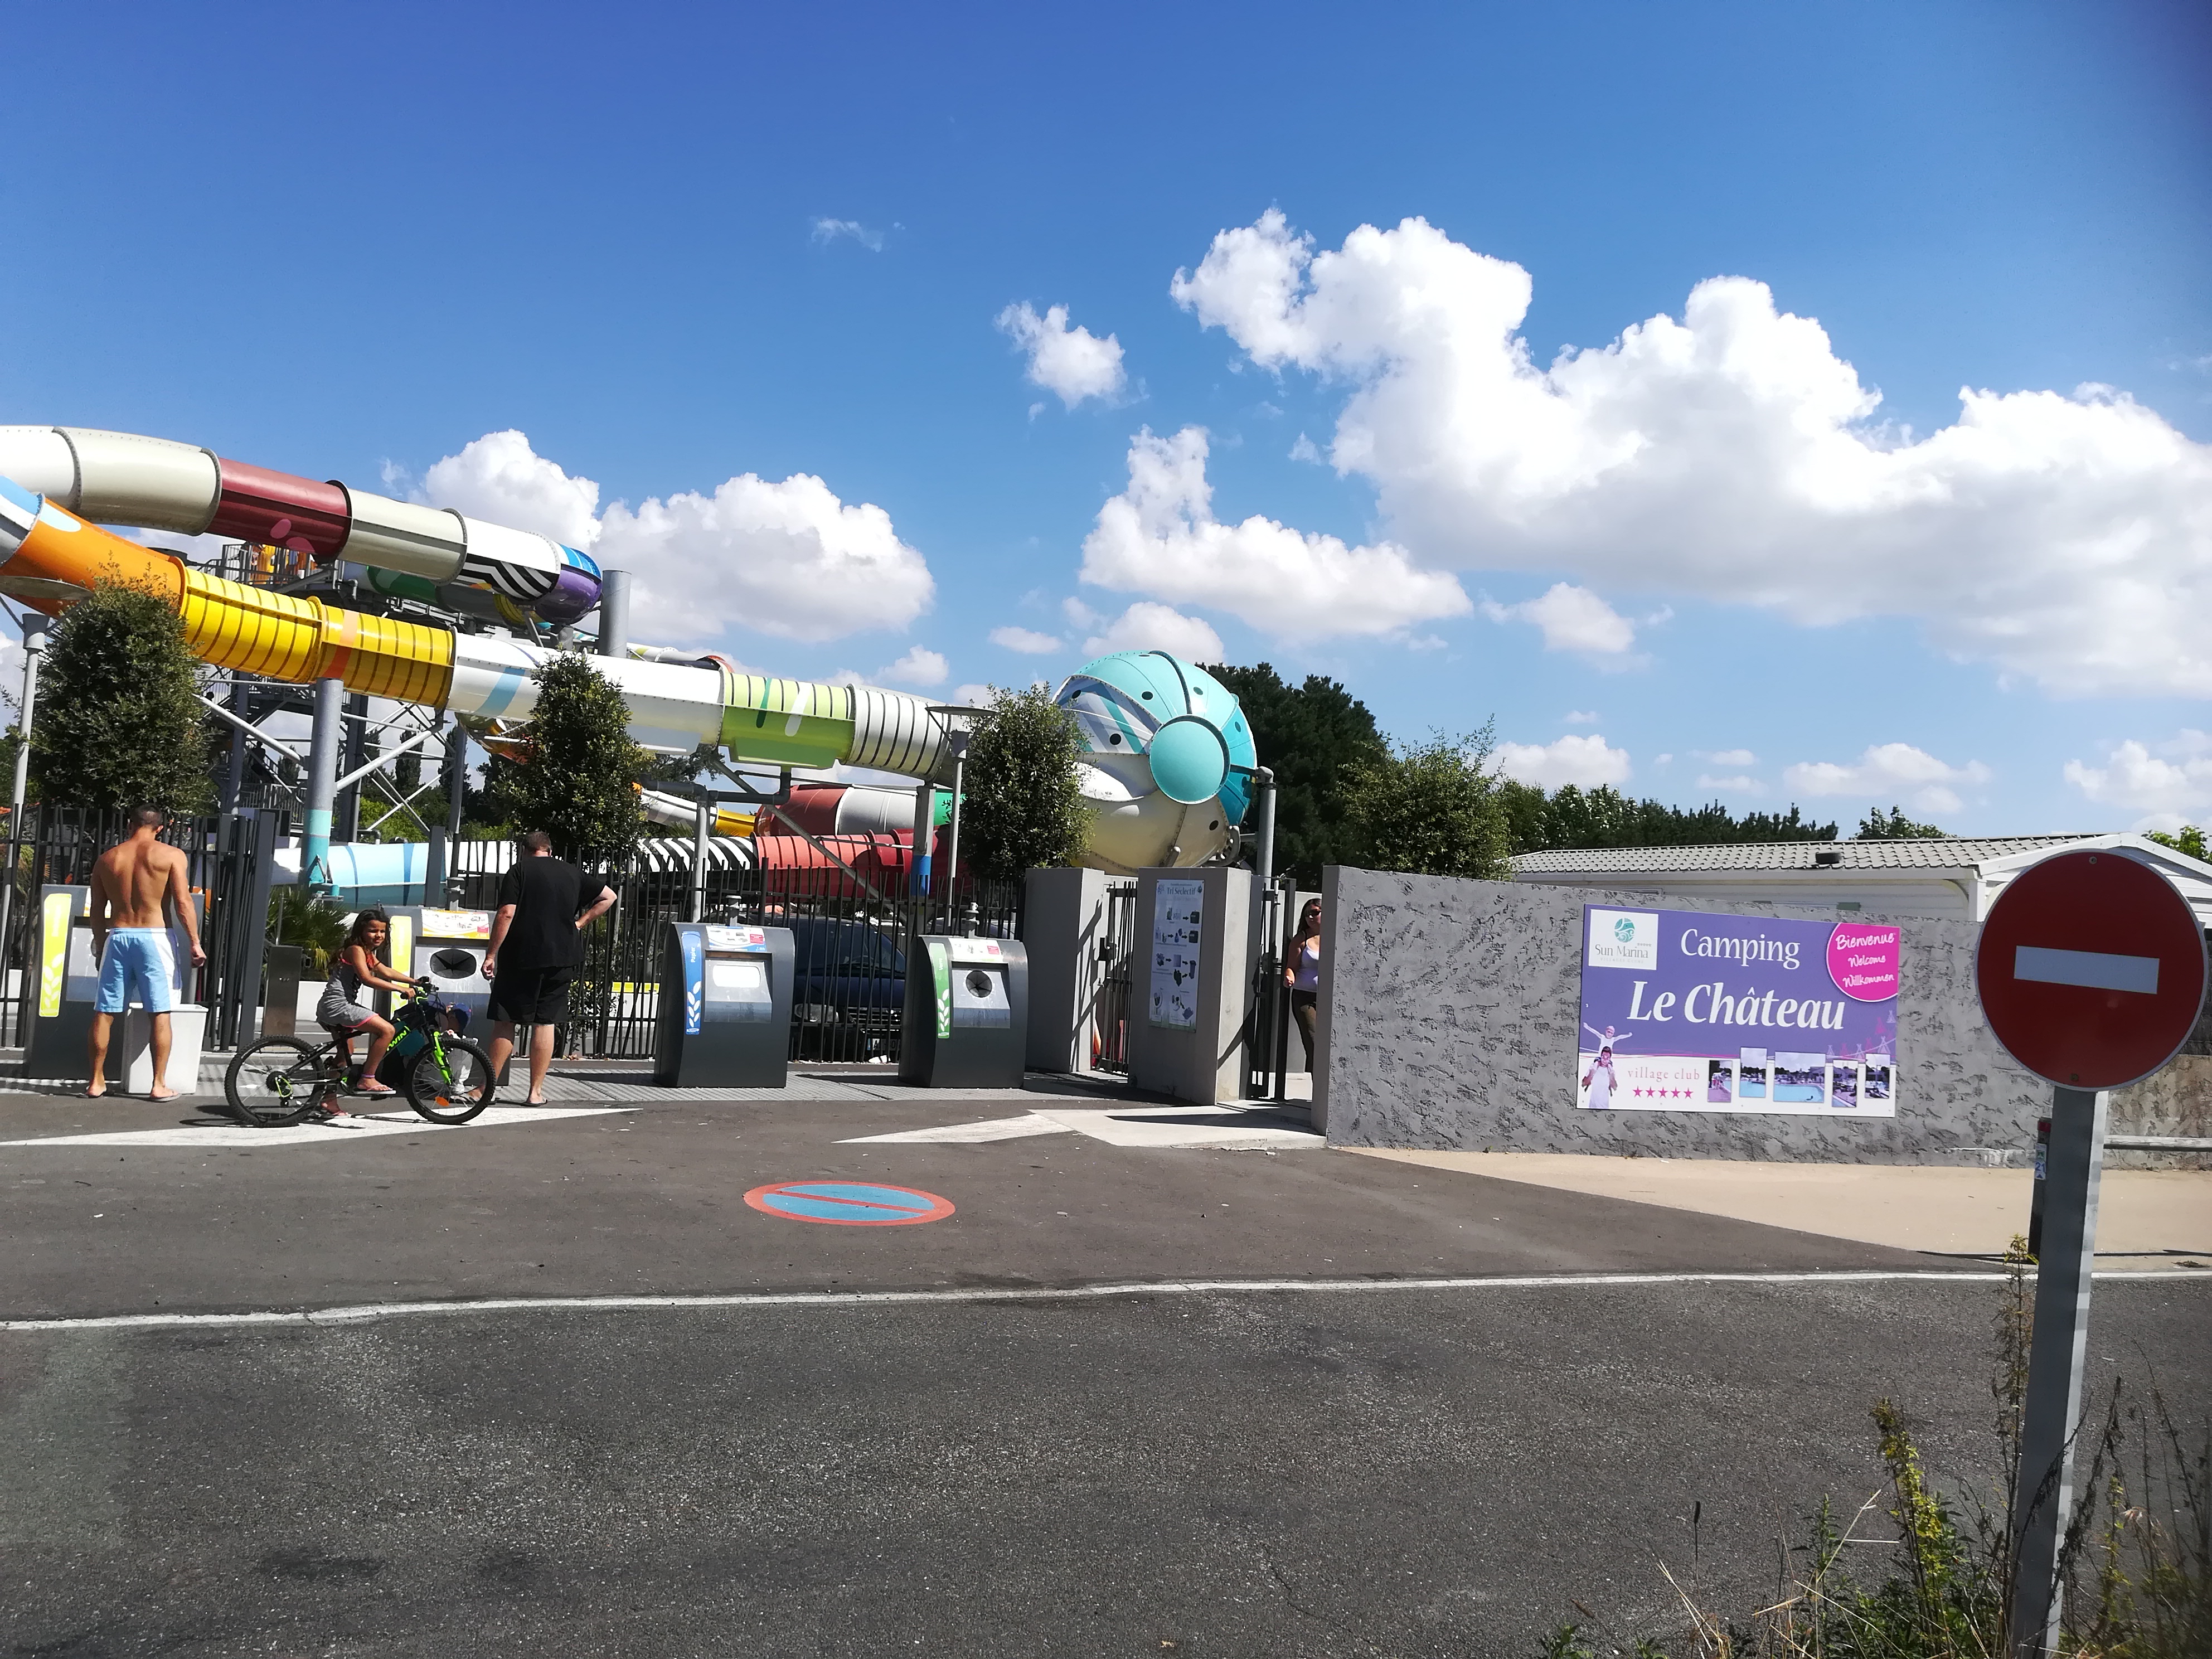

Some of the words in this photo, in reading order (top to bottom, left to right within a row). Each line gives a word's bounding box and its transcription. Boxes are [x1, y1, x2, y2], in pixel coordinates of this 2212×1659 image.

[1681, 928, 1801, 970] Camping
[1835, 933, 1894, 950] Bienvenue
[1595, 944, 1613, 956] Sun
[1617, 945, 1649, 958] Marina
[1848, 954, 1886, 967] Welcome
[1842, 974, 1895, 987] Willkommen
[1627, 981, 1676, 1021] Le
[1684, 982, 1845, 1030] Château
[1628, 1068, 1670, 1084] village
[1674, 1069, 1700, 1081] club
[2035, 1162, 2046, 1172] 21
